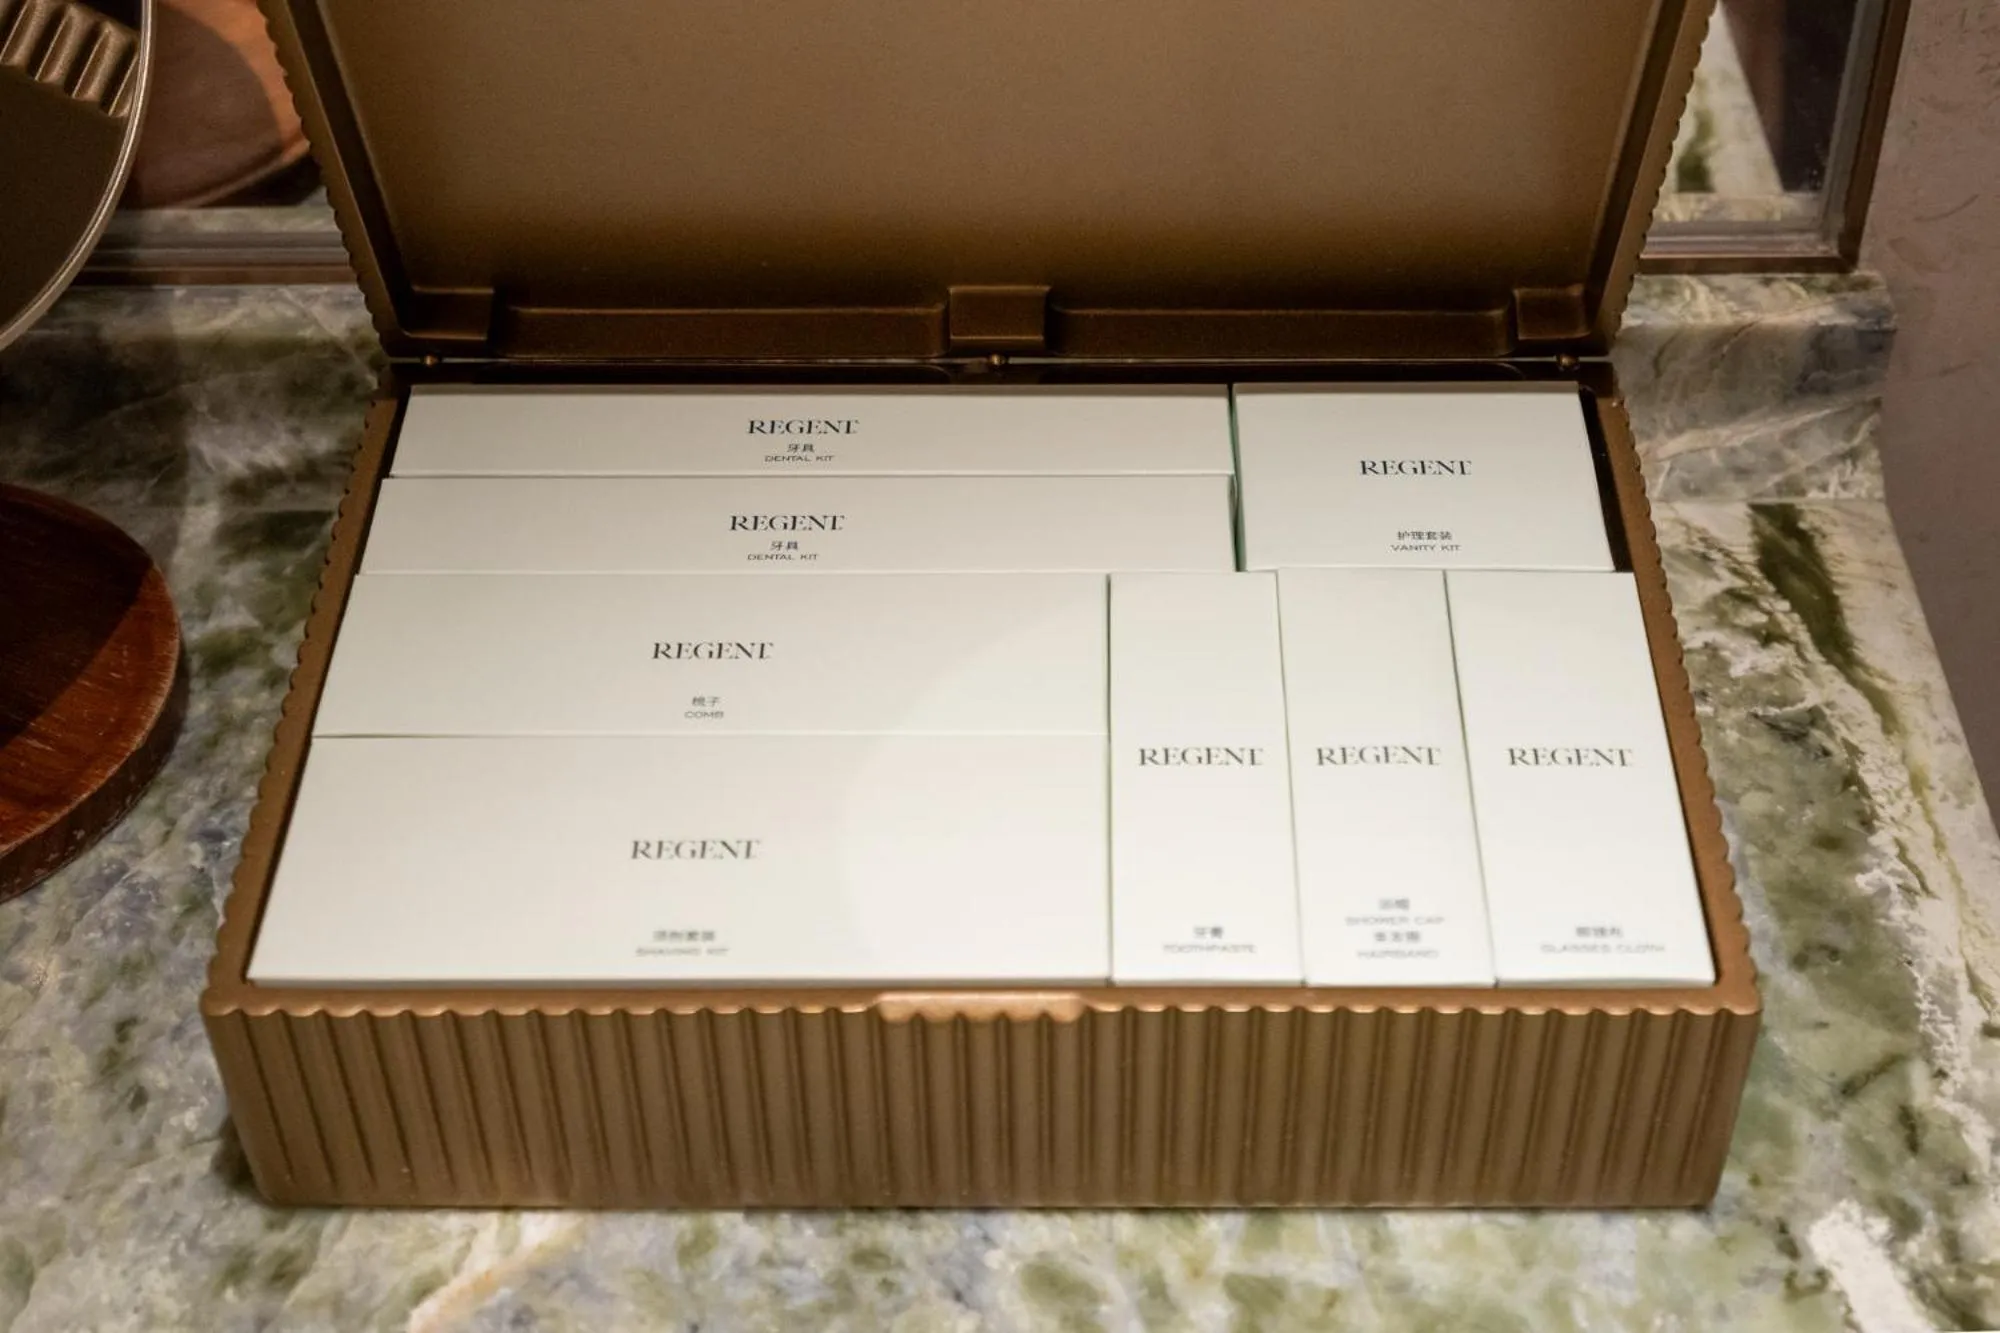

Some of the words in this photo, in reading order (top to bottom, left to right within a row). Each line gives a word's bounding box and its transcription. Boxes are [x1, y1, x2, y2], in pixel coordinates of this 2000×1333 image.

[748, 419, 859, 435] REGENT
[786, 443, 815, 454] 牙具
[764, 454, 810, 463] DENTAL
[815, 454, 834, 462] KIT
[1360, 459, 1472, 476] REGENT
[730, 514, 845, 531] REGENT
[1397, 530, 1453, 541] 护理套装
[770, 540, 799, 552] 牙具
[1390, 543, 1435, 552] VANITY
[1440, 543, 1461, 552] KIT
[747, 553, 793, 561] DENTAL
[799, 553, 819, 561] KIT
[652, 642, 774, 660] REGENT
[684, 709, 725, 719] COMB
[1139, 746, 1263, 767] REGENT
[1316, 745, 1442, 767] REGENT
[1507, 747, 1632, 768] REGENT
[631, 839, 760, 860] REGENT
[1345, 915, 1409, 926] SHOWER
[1413, 915, 1446, 926] CAP
